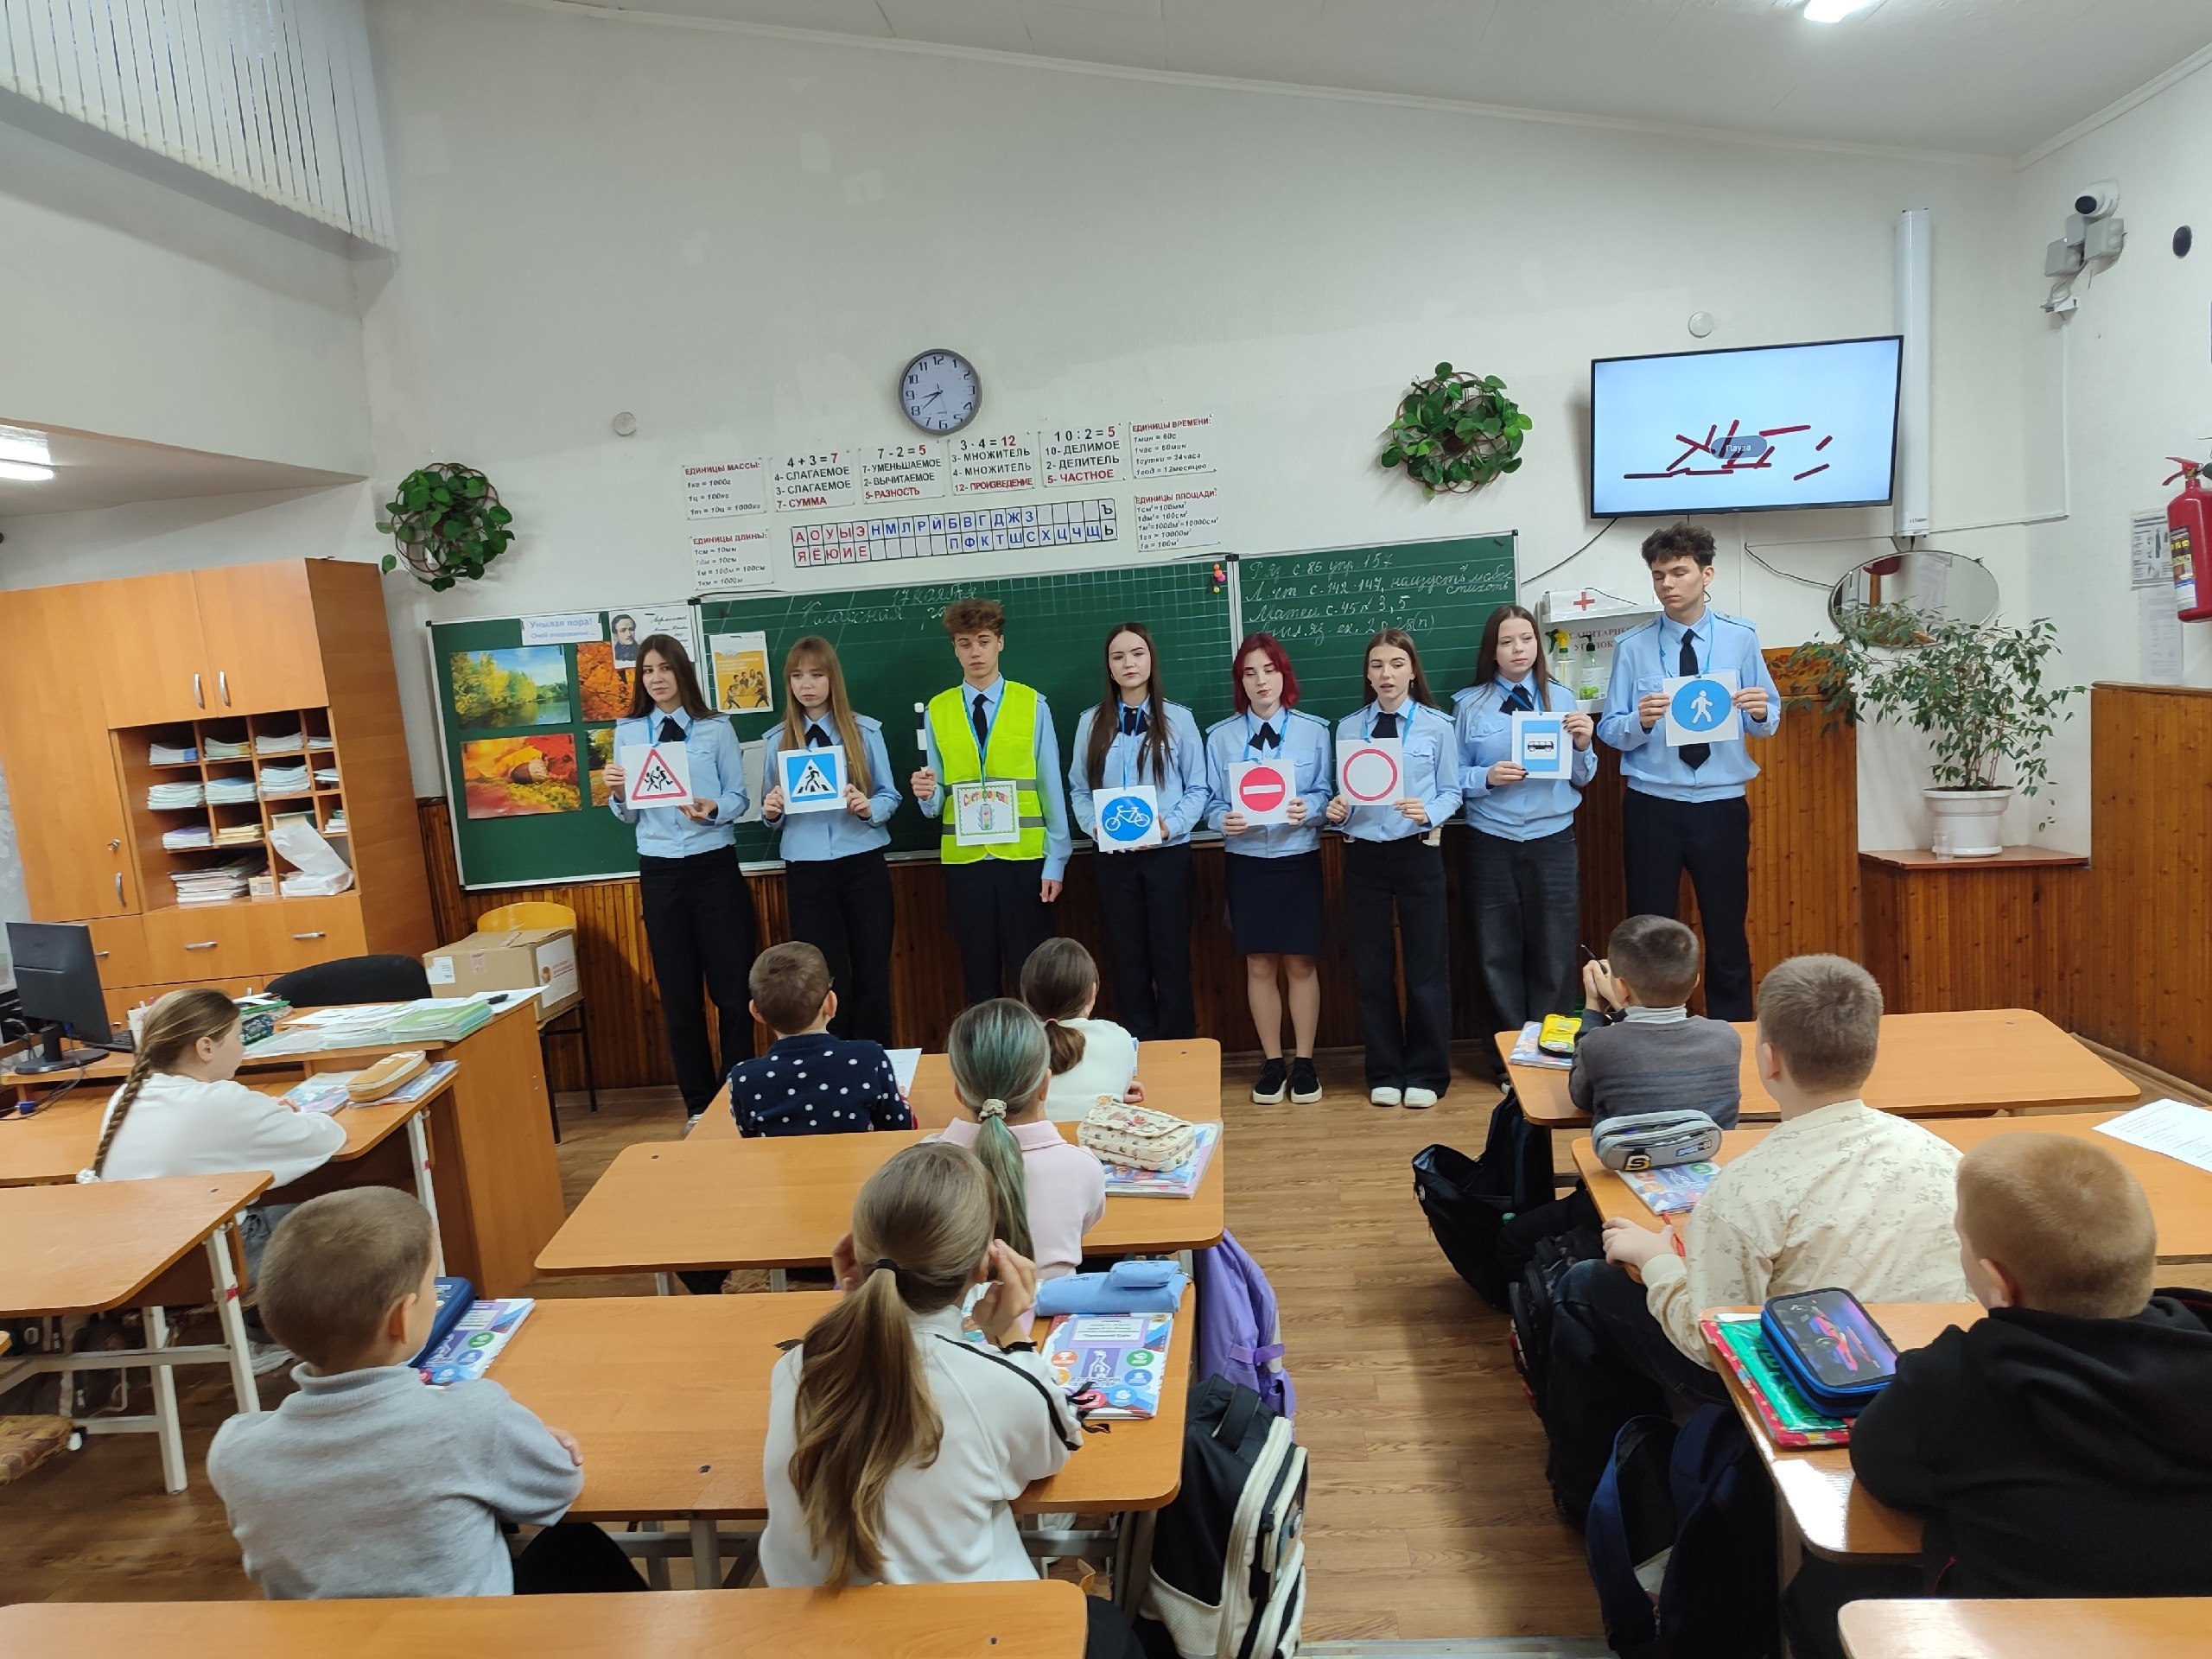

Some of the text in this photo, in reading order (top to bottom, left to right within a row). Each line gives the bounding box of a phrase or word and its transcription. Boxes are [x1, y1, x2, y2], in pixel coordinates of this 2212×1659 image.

[919, 362, 927, 371] 11
[933, 356, 944, 365] 12
[953, 359, 957, 368] 1
[908, 374, 918, 385] 10
[963, 371, 971, 380] 2
[906, 391, 915, 400] 9
[912, 406, 920, 416] 8
[963, 402, 972, 410] 4
[924, 417, 931, 427] 7
[938, 420, 948, 429] 6
[953, 414, 963, 423] 5
[1133, 417, 1211, 432] ЕДИНИЦЫ ВРЕМЕНИ:
[1085, 429, 1092, 439] 2
[1108, 426, 1115, 437] 5
[961, 435, 1016, 450] 3 4 12
[1064, 441, 1120, 455] ДЕЛИМОЕ
[1726, 444, 1751, 453] Пауза
[878, 445, 925, 459] 7 2 5
[964, 448, 1030, 461] МНОЖИТЕЛЬ
[787, 453, 837, 467] 4 3 7
[872, 459, 941, 473] УМЕНЬШАЕМОЕ
[1059, 455, 1119, 470] ДЕЛИТЕЛЬ
[685, 462, 760, 475] ЕДИНИЦЫ МАССЫ:
[786, 467, 850, 480] СЛАГАЕМОЕ
[965, 462, 1031, 476] МНОЖИТЕЛЬ
[874, 473, 935, 485] ВЫЧИТАЕМОЕ
[1060, 469, 1114, 482] ЧАСТНОЕ
[788, 480, 851, 494] СЛАГАЕМОЕ
[970, 478, 1033, 491] ПРОИЗВЕДЕНИЕ
[874, 487, 920, 499] РАЗНОСТЬ
[1135, 490, 1217, 505] ЕДИНИЦЫ ПЛОЩАДИ:
[789, 497, 827, 508] СУММА
[796, 505, 1112, 543] А О У Ы Э Н М Л Р Й Б В Г Д Ж З Ъ
[693, 532, 767, 544] ЕДИНИЦЫ ДЛИНЫ:
[798, 524, 1113, 562] Я Ё Ю И Е П Ф К Т Ш С Х Ц Ч Щ Ь
[529, 620, 566, 629] Унылая
